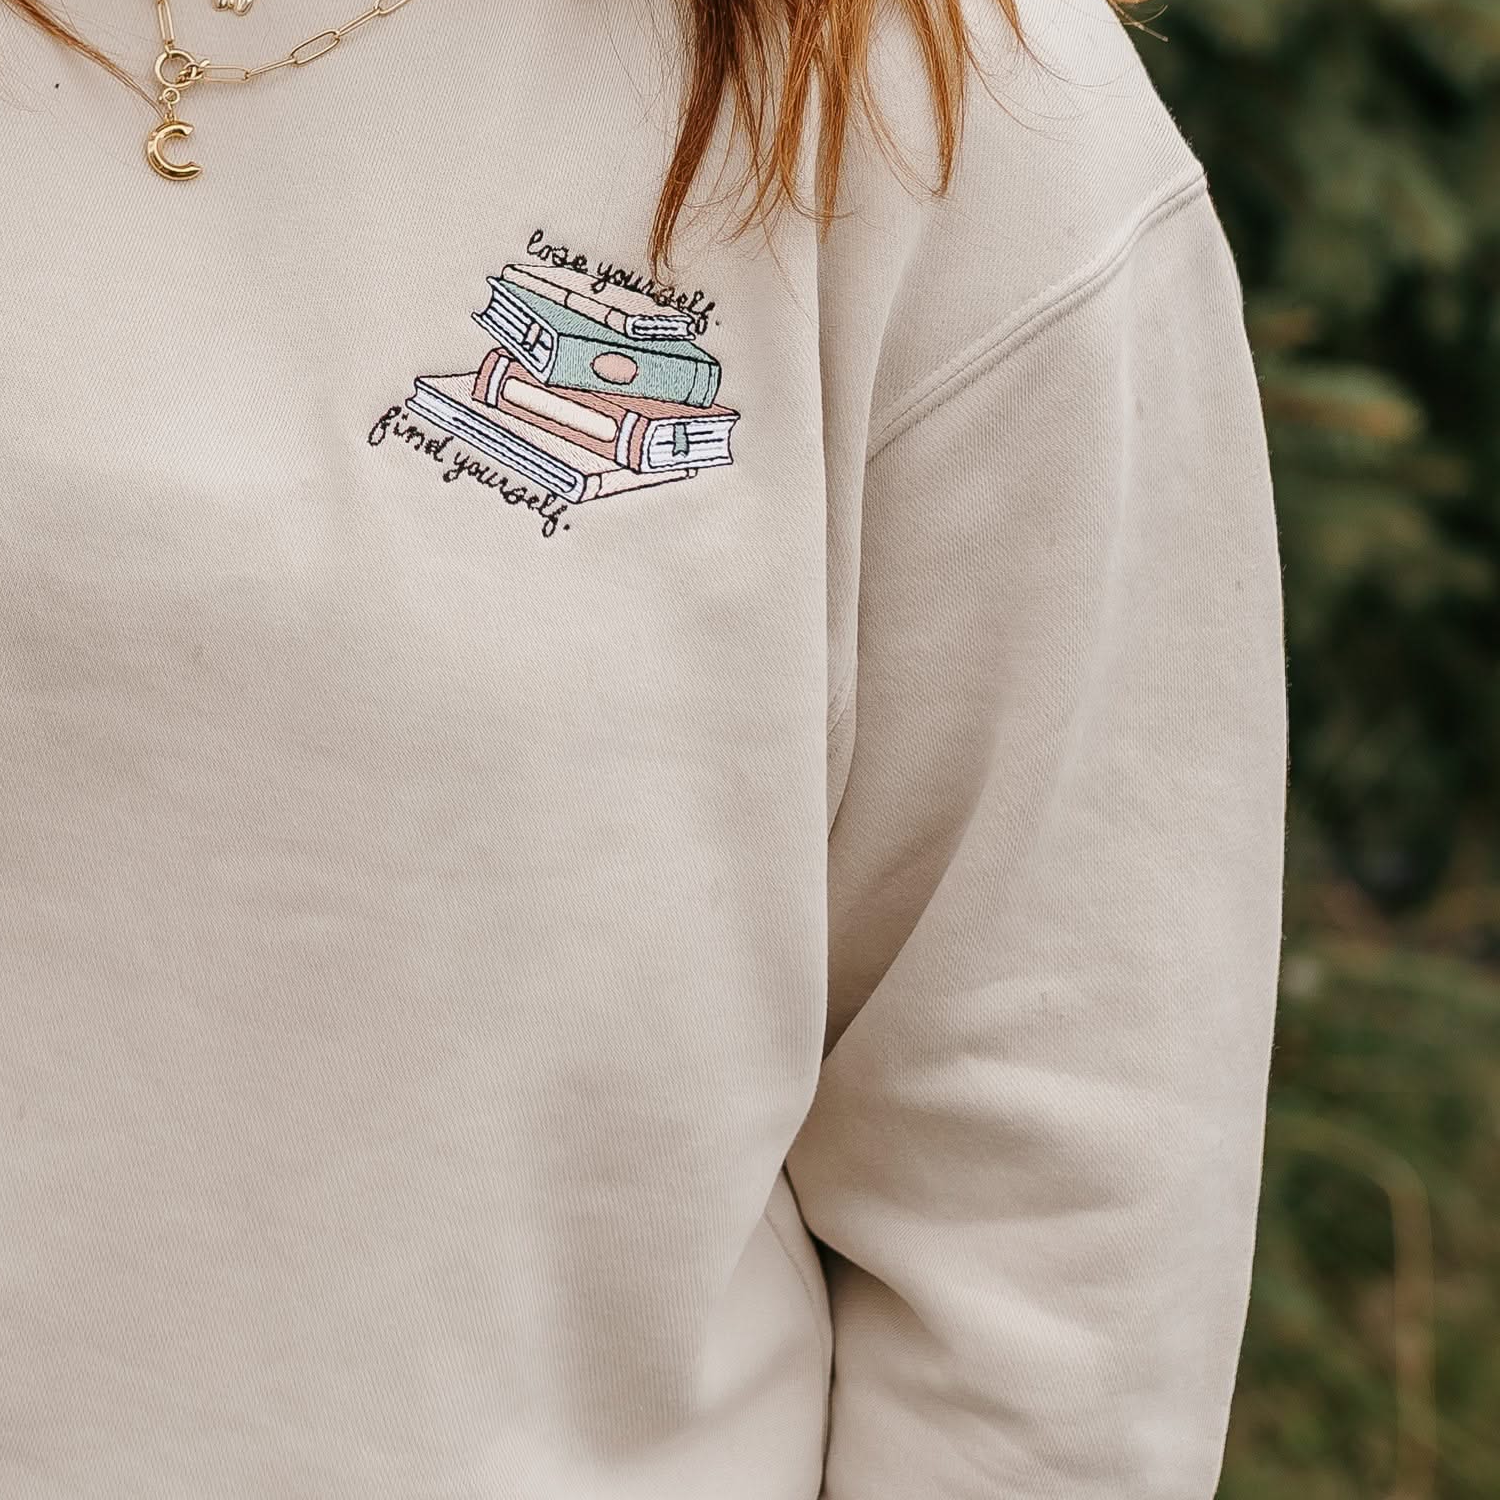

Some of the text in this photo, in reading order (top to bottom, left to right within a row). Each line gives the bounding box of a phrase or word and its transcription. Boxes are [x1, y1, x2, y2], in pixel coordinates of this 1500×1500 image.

[526, 228, 589, 274] lose
[367, 405, 571, 538] find yourself.
